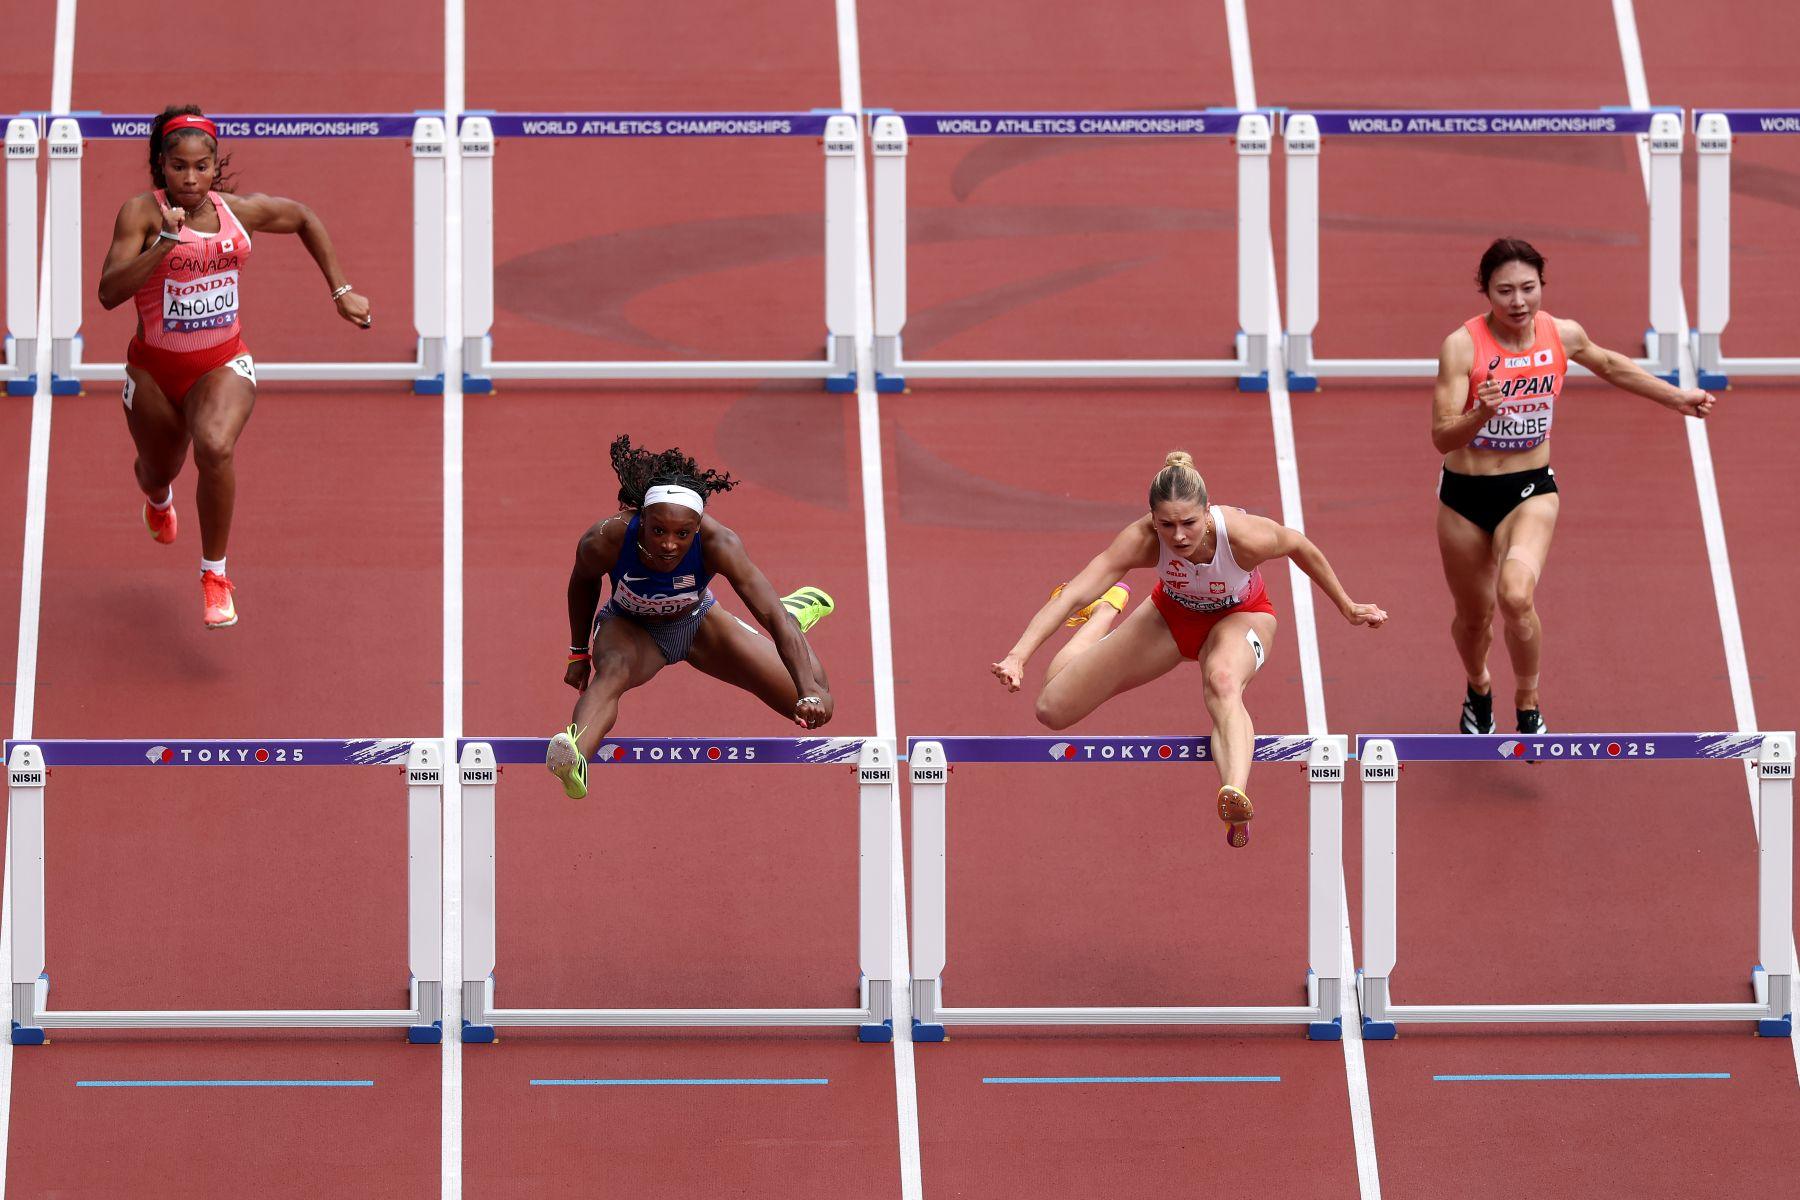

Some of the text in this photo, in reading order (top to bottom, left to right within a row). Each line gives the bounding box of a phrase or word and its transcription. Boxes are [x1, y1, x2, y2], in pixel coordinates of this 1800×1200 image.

[111, 122, 152, 136] WORL
[254, 121, 379, 136] CHAMPIONSHIPS
[522, 120, 792, 135] WORLD ATHLETICS CHAMPIONSHIPS
[936, 118, 1205, 134] WORLD ATHLETICS CHAMPIONSHIPS
[1348, 117, 1616, 132] WORLD ATHLETICS CHAMPIONSHIPS
[1760, 117, 1800, 131] WORL
[415, 145, 442, 153] NISHI
[464, 144, 489, 153] NISHI
[1240, 142, 1266, 150] NISHI
[1289, 142, 1315, 150] NISHI
[1652, 140, 1678, 149] NISHI
[1701, 140, 1727, 149] NISHI
[8, 146, 35, 154] NISHI
[51, 146, 78, 154] NISHI
[169, 256, 239, 273] CANADA
[166, 276, 235, 297] HONDA
[168, 292, 234, 317] AHOLOU
[1498, 375, 1554, 397] APAN
[1497, 402, 1550, 416] ONDA
[1484, 418, 1547, 436] UKUBE
[1166, 570, 1187, 578] ORLEN
[633, 746, 756, 761] TOKYO25
[1084, 745, 1206, 760] TOKYO25
[1533, 742, 1656, 757] TOKYO25
[181, 748, 304, 763] TOKYO25
[914, 770, 943, 780] NISHI
[1311, 769, 1340, 778] NISHI
[1365, 768, 1394, 778] NISHI
[1762, 765, 1791, 775] NISHI
[12, 773, 41, 783] NISHI
[410, 772, 439, 781] NISHI
[463, 771, 493, 781] NISHI
[862, 771, 890, 780] NISHI
